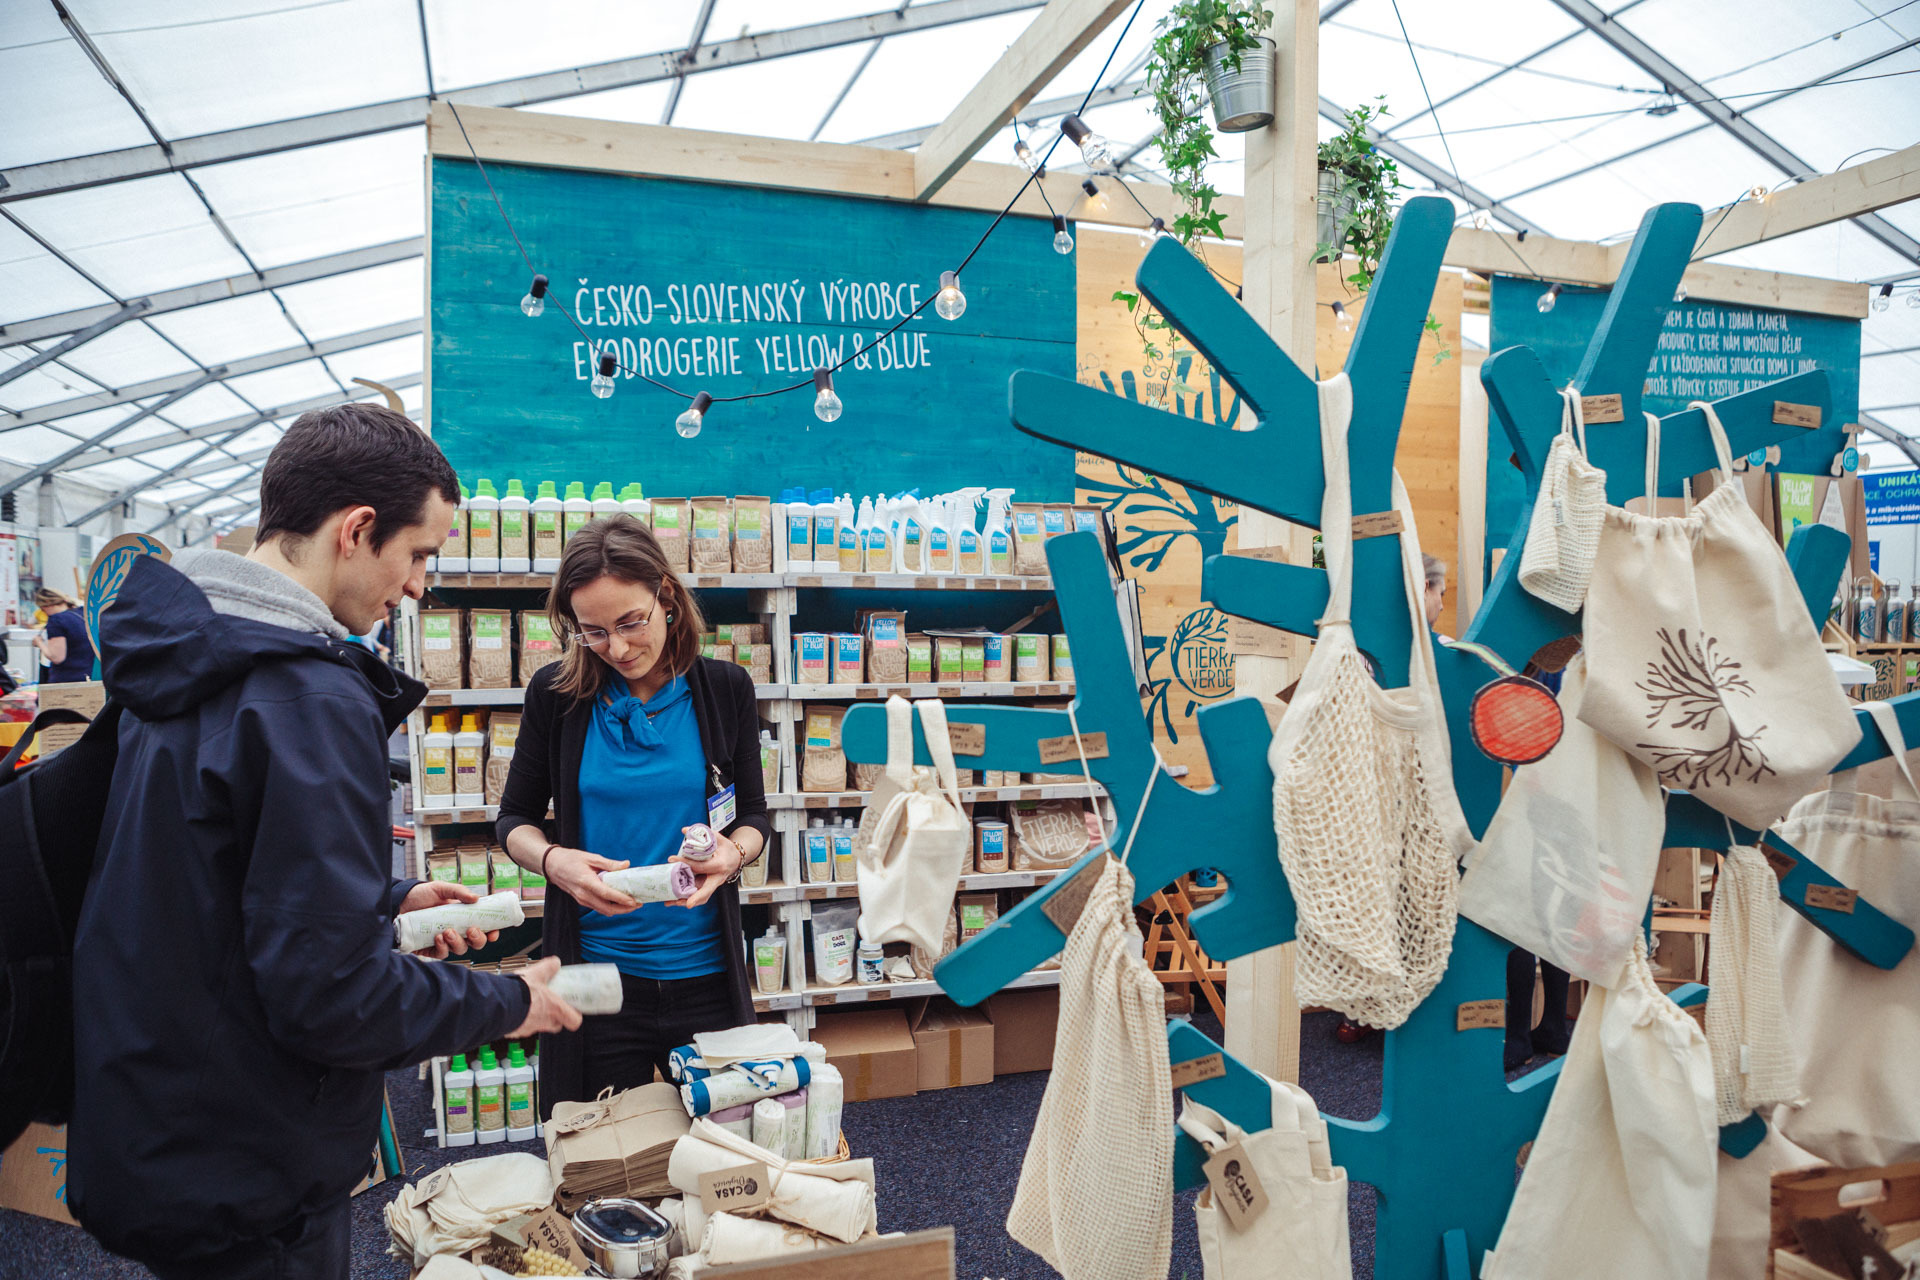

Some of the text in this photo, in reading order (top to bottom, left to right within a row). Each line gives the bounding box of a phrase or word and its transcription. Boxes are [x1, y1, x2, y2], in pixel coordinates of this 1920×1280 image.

[575, 278, 922, 327] ČESKO-SLOVENSKÝ VÝROBCE
[1662, 310, 1682, 328] NEM
[1685, 311, 1694, 329] JE
[1719, 312, 1725, 329] A
[1728, 311, 1755, 331] ZDRAVÁ
[1723, 331, 1741, 351] NÁM
[573, 331, 931, 380] EKODROGERIE YELLOW & BLUE
[1662, 355, 1668, 372] V
[1671, 352, 1728, 374] KAŽDODENNÍCH
[1730, 354, 1765, 376] SITUACÍCH
[1768, 357, 1788, 376] DOMA
[1146, 383, 1168, 397] BORN
[1672, 375, 1705, 397] VŽDYCKY
[1190, 668, 1233, 689] VERDE
[1022, 811, 1082, 839] TIERRA
[1034, 831, 1081, 856] VERDE
[715, 1186, 743, 1199] CASA
[1235, 1175, 1255, 1207] CASA
[539, 1221, 559, 1248] CASA
